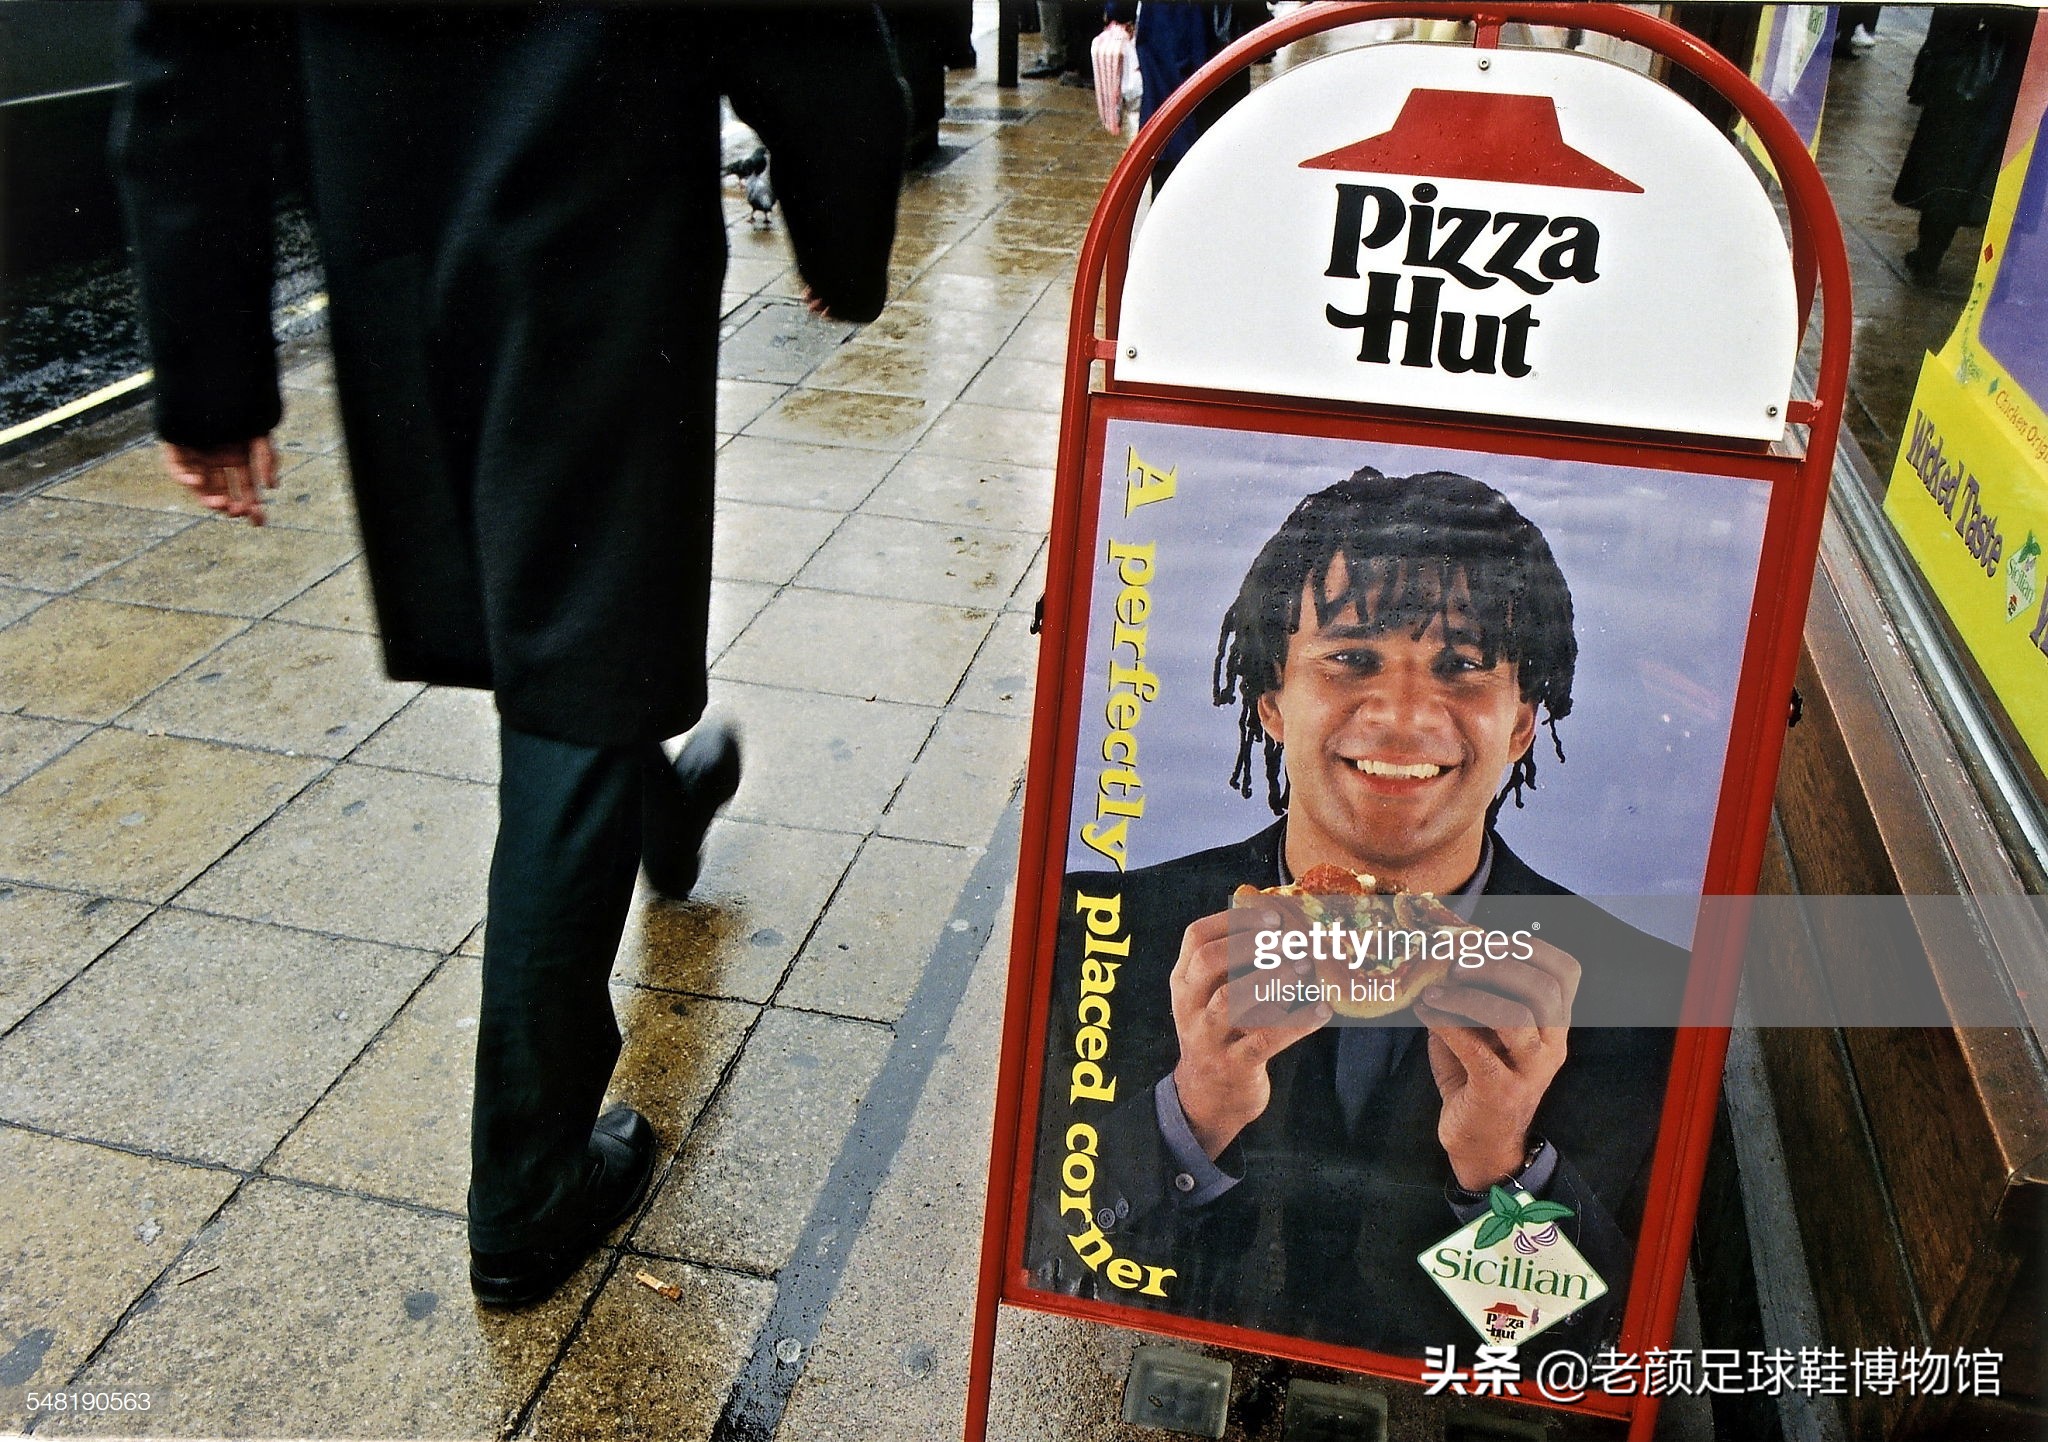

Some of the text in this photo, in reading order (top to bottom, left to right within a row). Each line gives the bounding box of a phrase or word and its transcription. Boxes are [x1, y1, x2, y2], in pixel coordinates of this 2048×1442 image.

[1324, 183, 1600, 295] Pizza
[1326, 272, 1540, 378] Hut
[1905, 409, 2004, 578] Wicked Taste
[1060, 445, 1179, 1298] A perfectly placed corner
[1432, 1248, 1588, 1301] Sicilian
